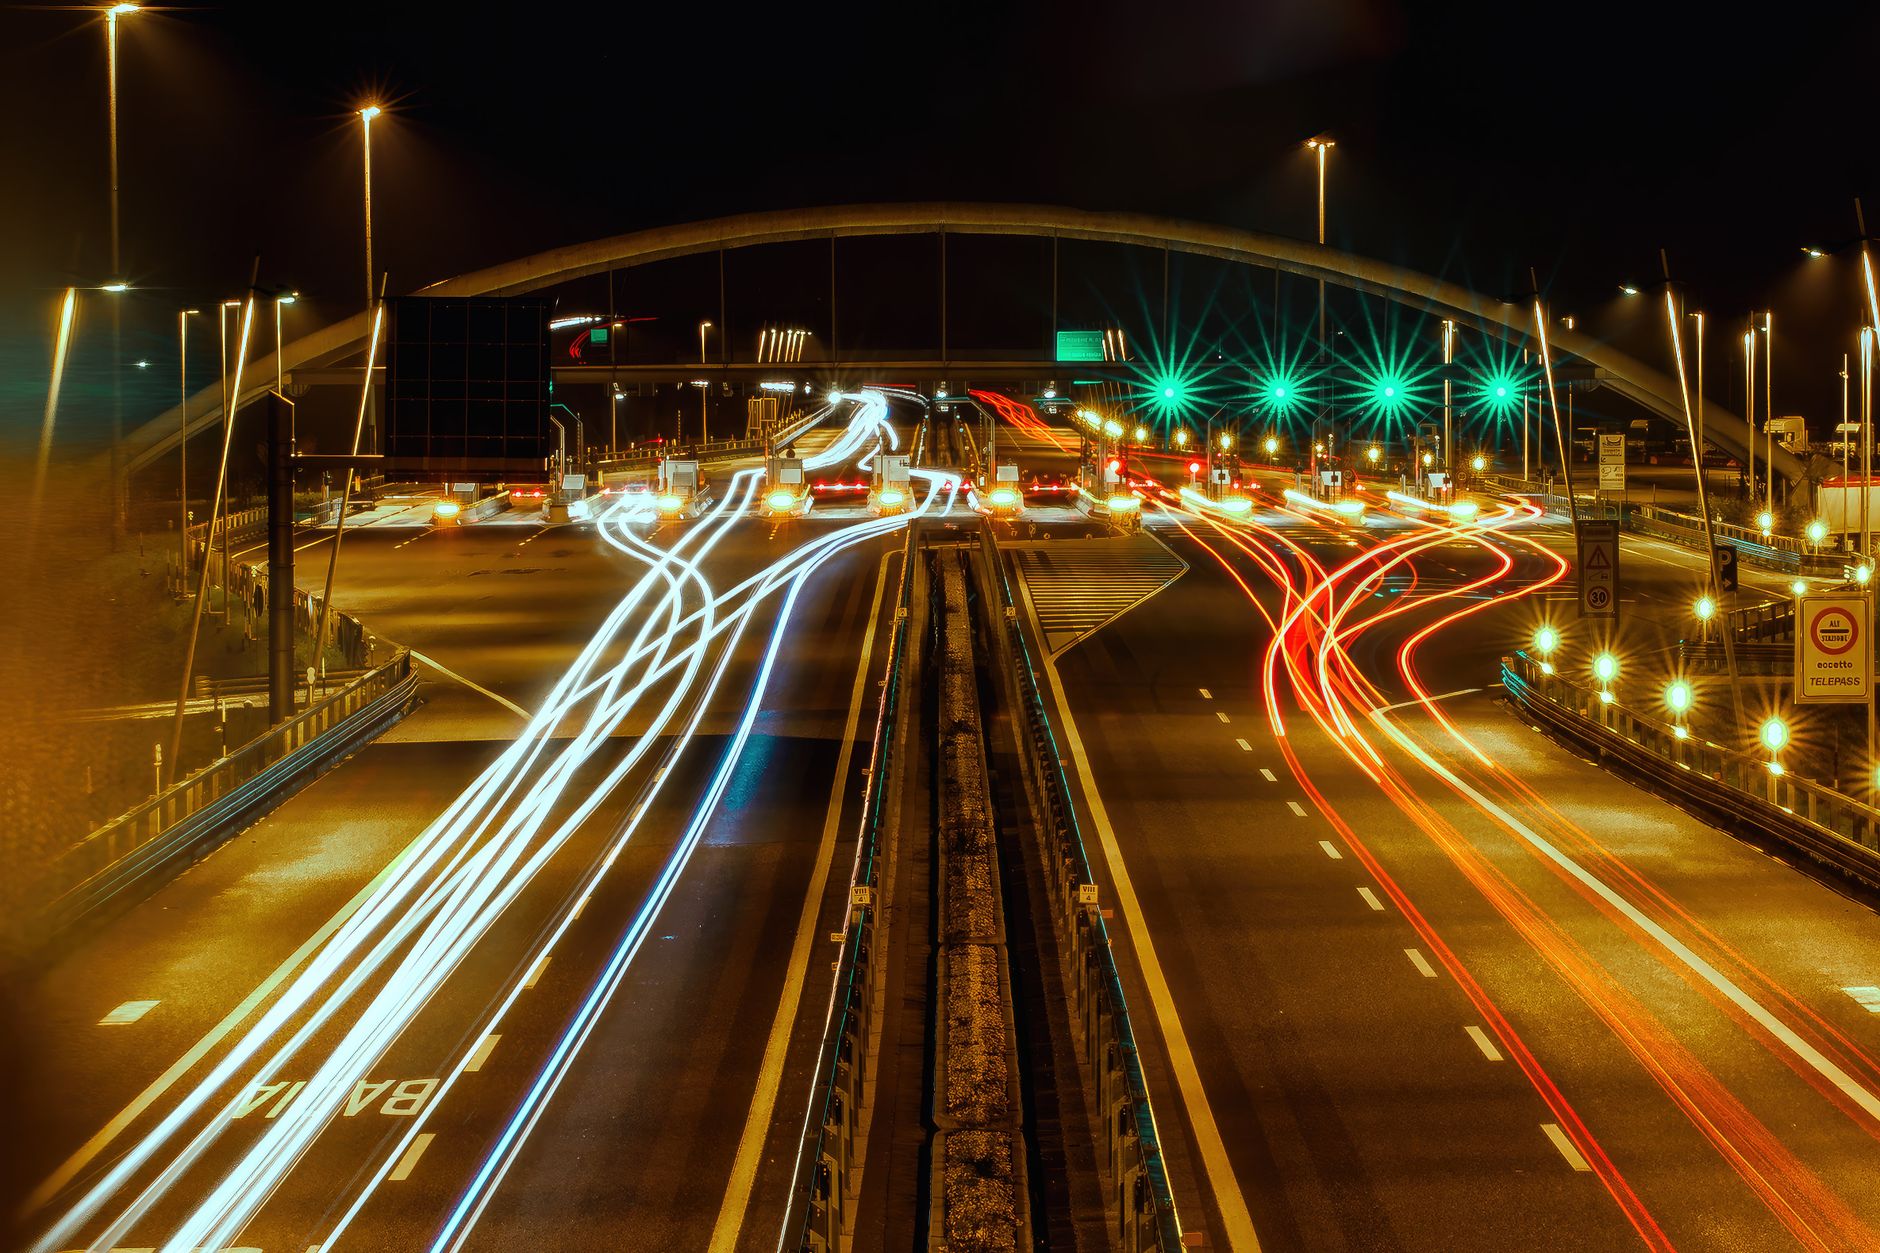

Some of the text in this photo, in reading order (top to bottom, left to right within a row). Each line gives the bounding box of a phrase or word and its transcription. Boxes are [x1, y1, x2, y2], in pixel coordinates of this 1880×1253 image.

[1591, 591, 1606, 604] 30
[1829, 620, 1840, 628] ALT
[1817, 661, 1853, 669] eccetto
[1810, 677, 1861, 686] TELEPASS
